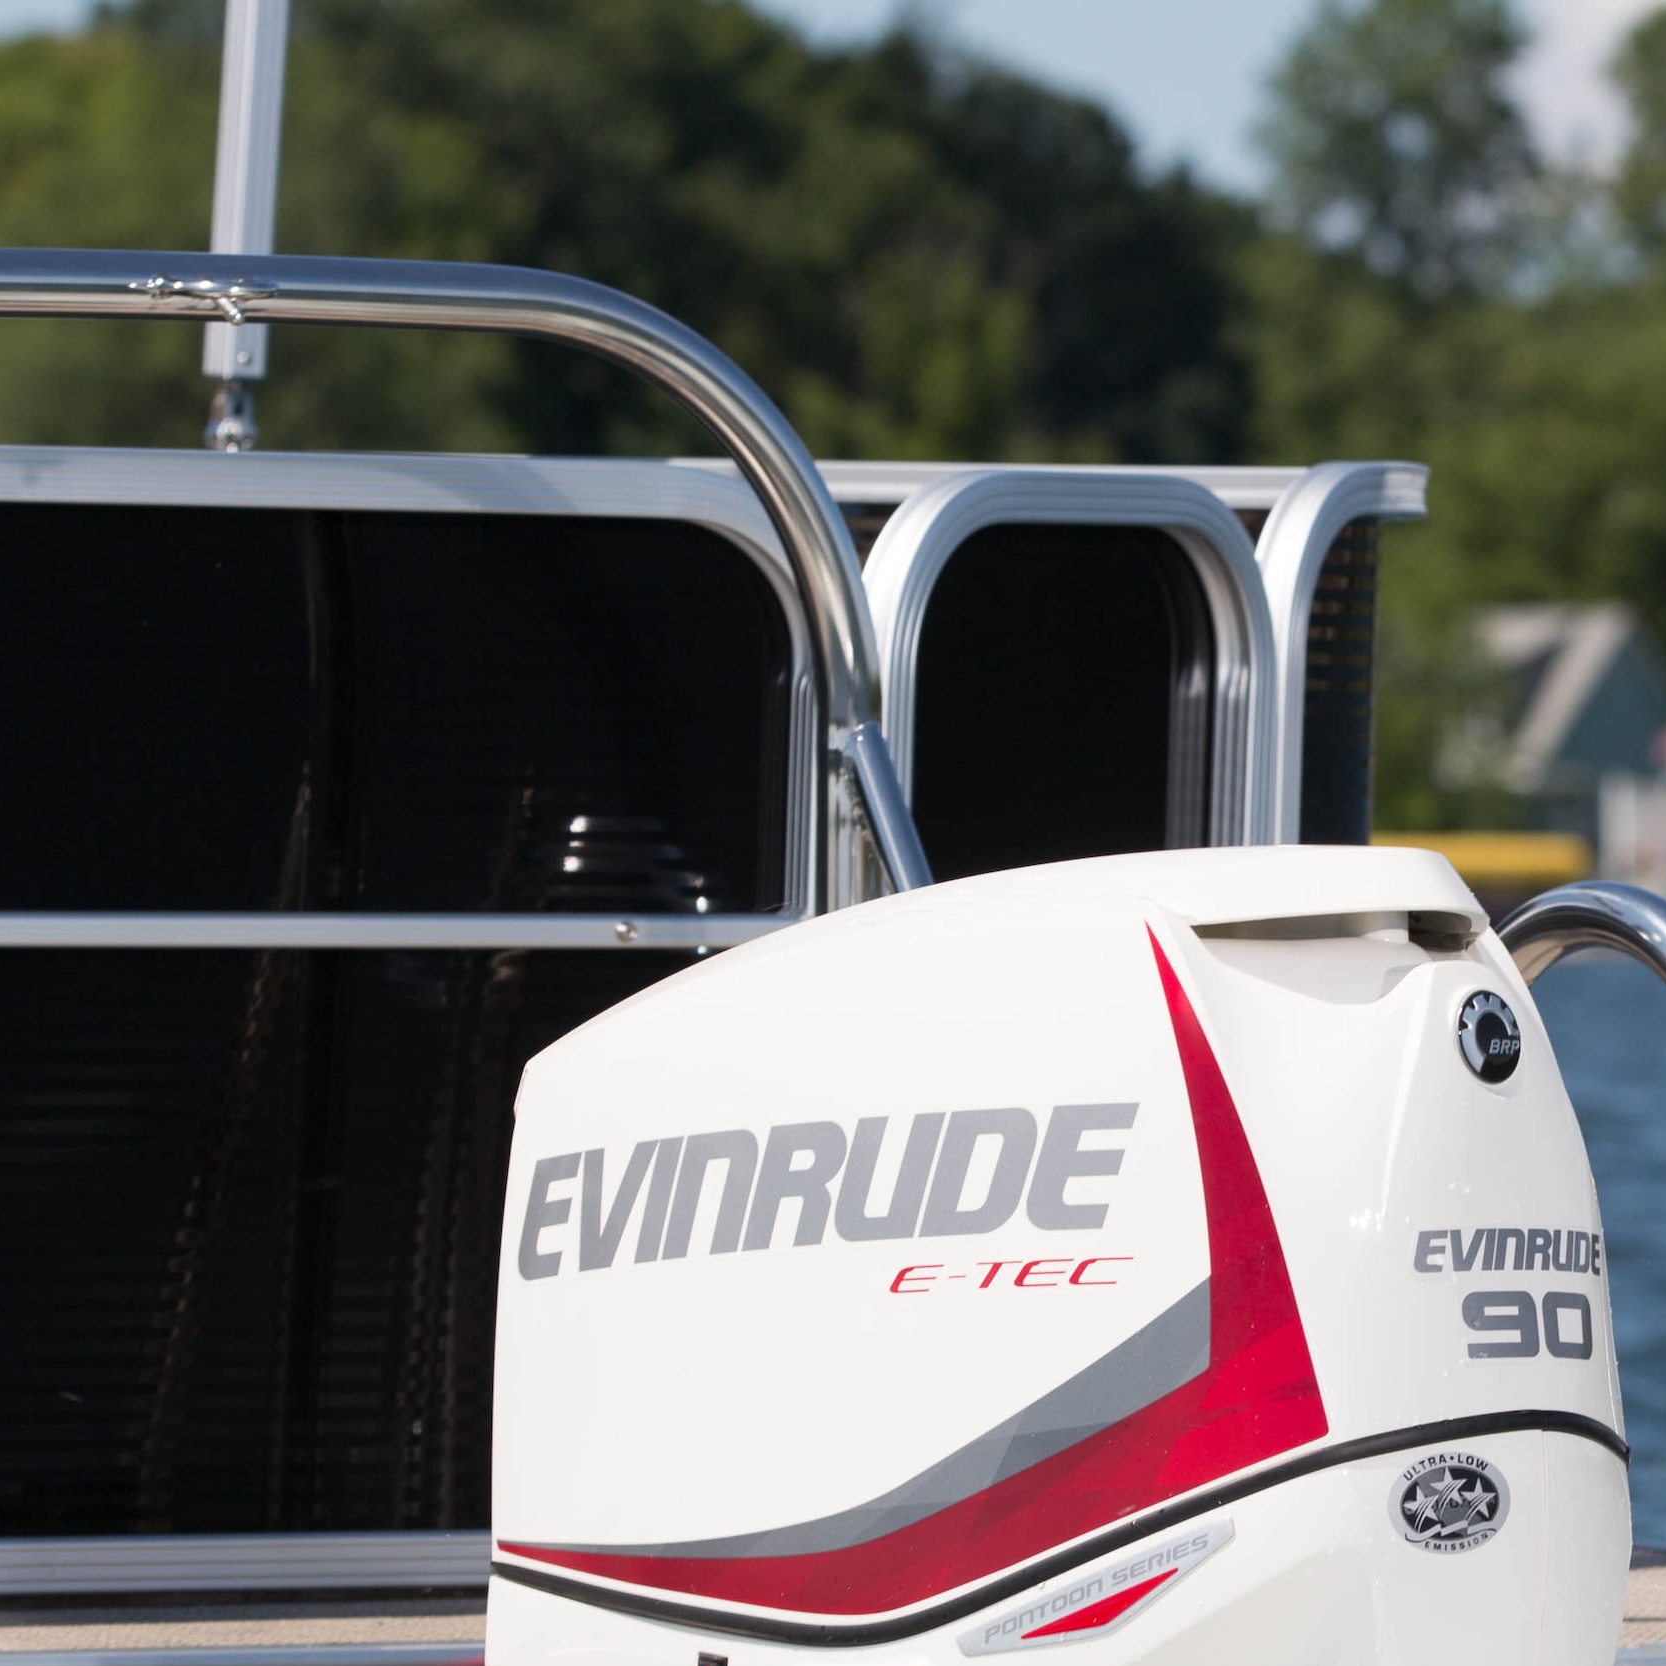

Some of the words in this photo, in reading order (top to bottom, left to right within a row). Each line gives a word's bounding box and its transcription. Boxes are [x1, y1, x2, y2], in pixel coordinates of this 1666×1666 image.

[1488, 1038, 1520, 1054] BRP
[517, 1102, 1140, 1281] EVINRUDE
[889, 1257, 1135, 1294] E-TEC
[1413, 1227, 1601, 1277] EVINRUDE
[1461, 1290, 1593, 1361] 90
[1424, 1532, 1489, 1552] EMISSION
[984, 1576, 1104, 1645] PONTOON
[1111, 1533, 1210, 1589] SERIES
